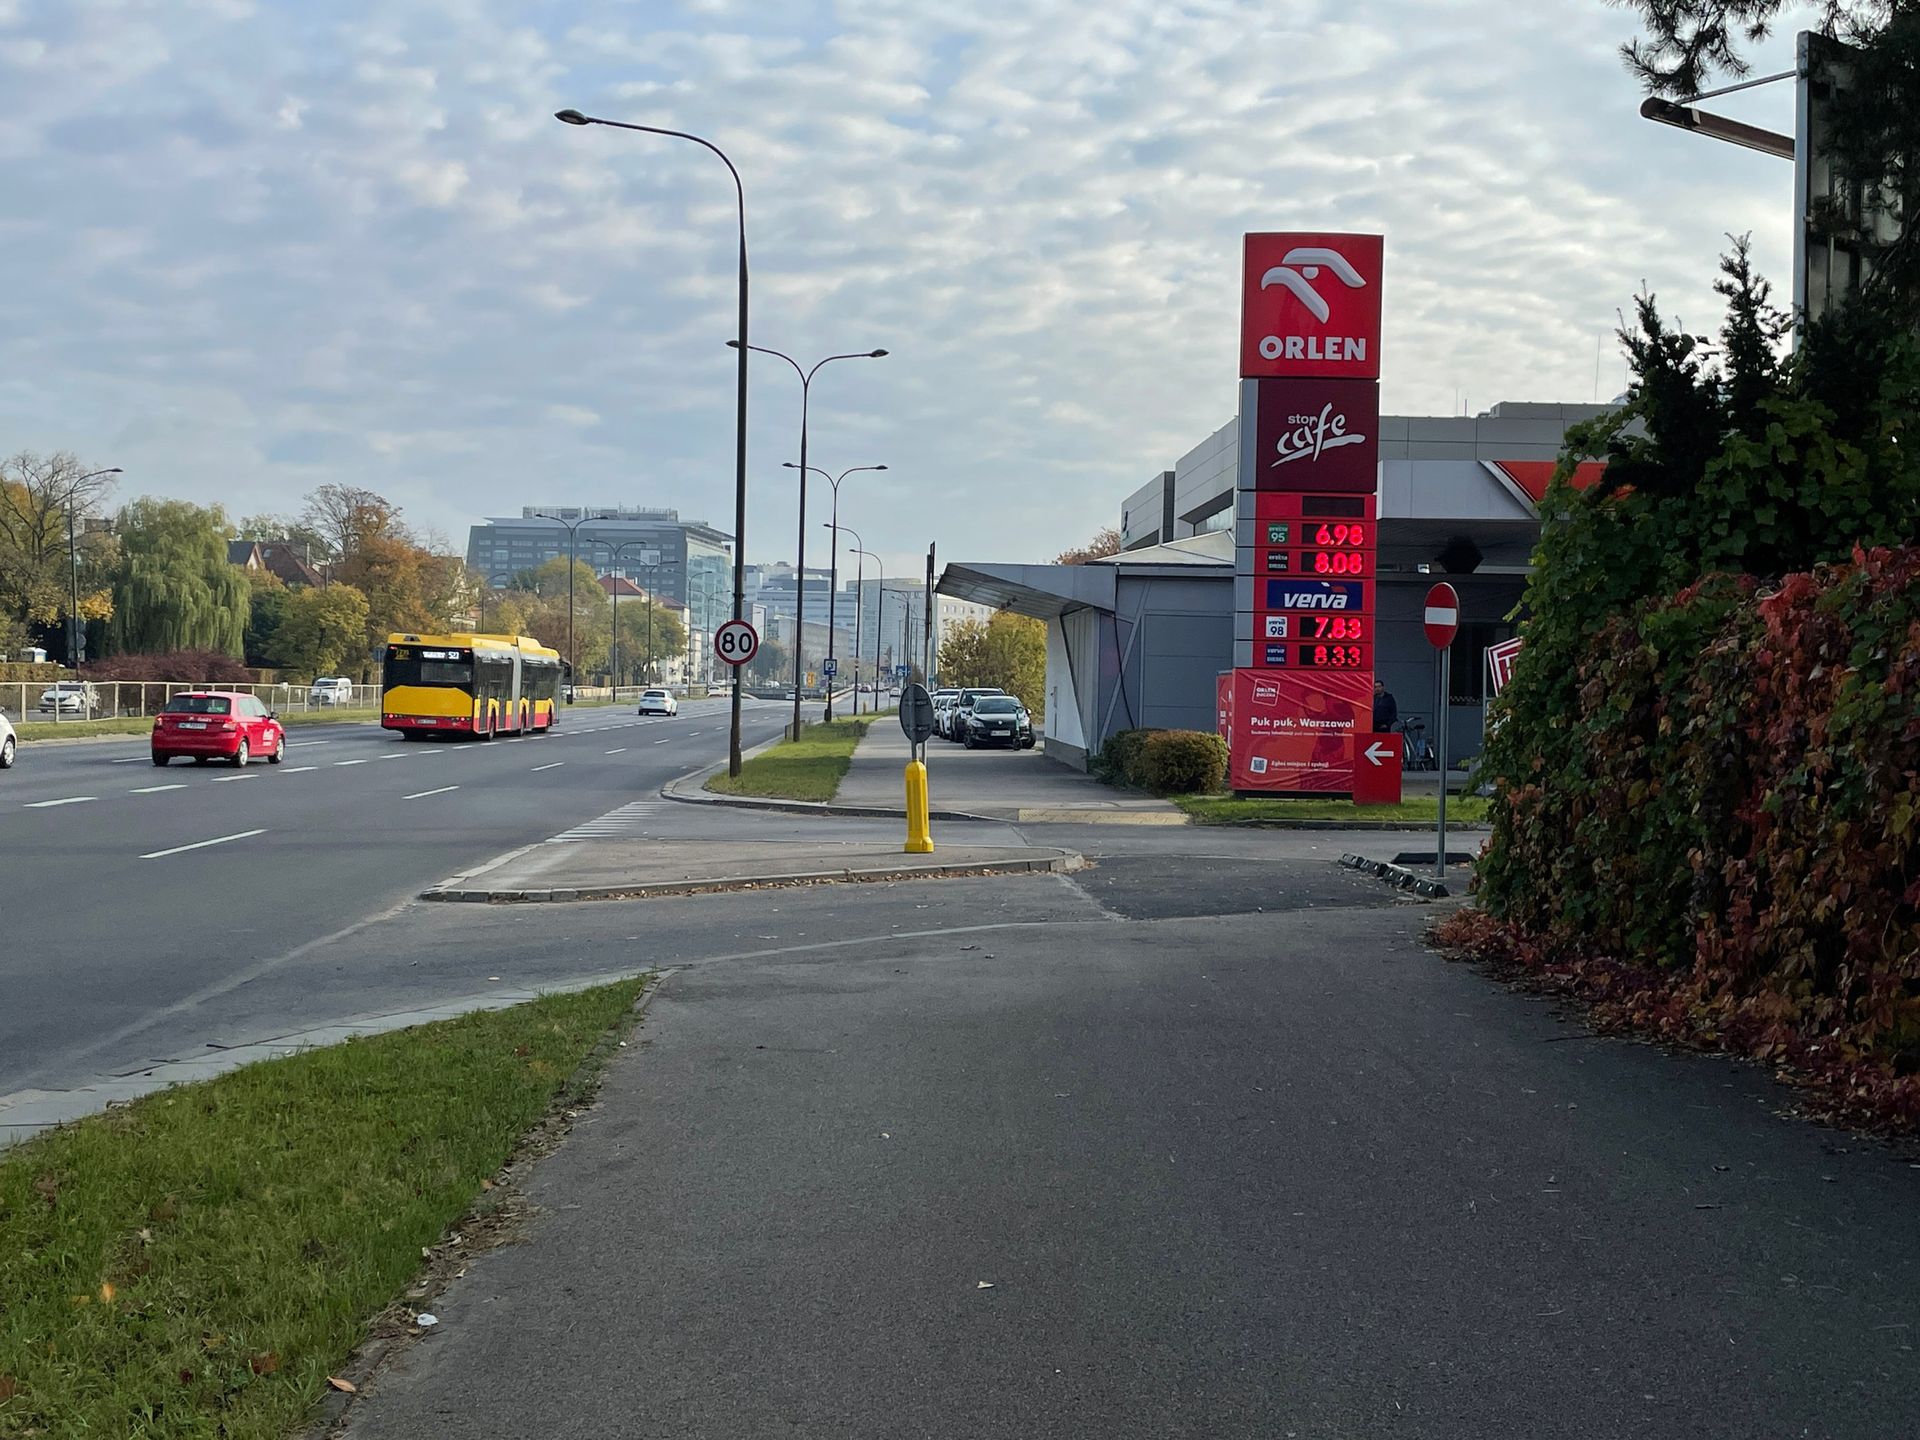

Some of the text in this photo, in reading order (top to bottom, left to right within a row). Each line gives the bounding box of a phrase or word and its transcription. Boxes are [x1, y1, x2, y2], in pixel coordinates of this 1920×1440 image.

[1258, 335, 1366, 361] ORLEN
[1276, 402, 1347, 462] cafe
[1271, 532, 1285, 542] 95
[1315, 523, 1364, 546] 6.98
[1314, 551, 1362, 575] 8.08
[1284, 593, 1348, 609] verva
[1270, 626, 1284, 636] 98
[1315, 616, 1362, 640] 7.83
[721, 632, 752, 654] 80
[1314, 645, 1361, 667] 8.33
[1251, 717, 1354, 728] Puk puk, Warszawo!
